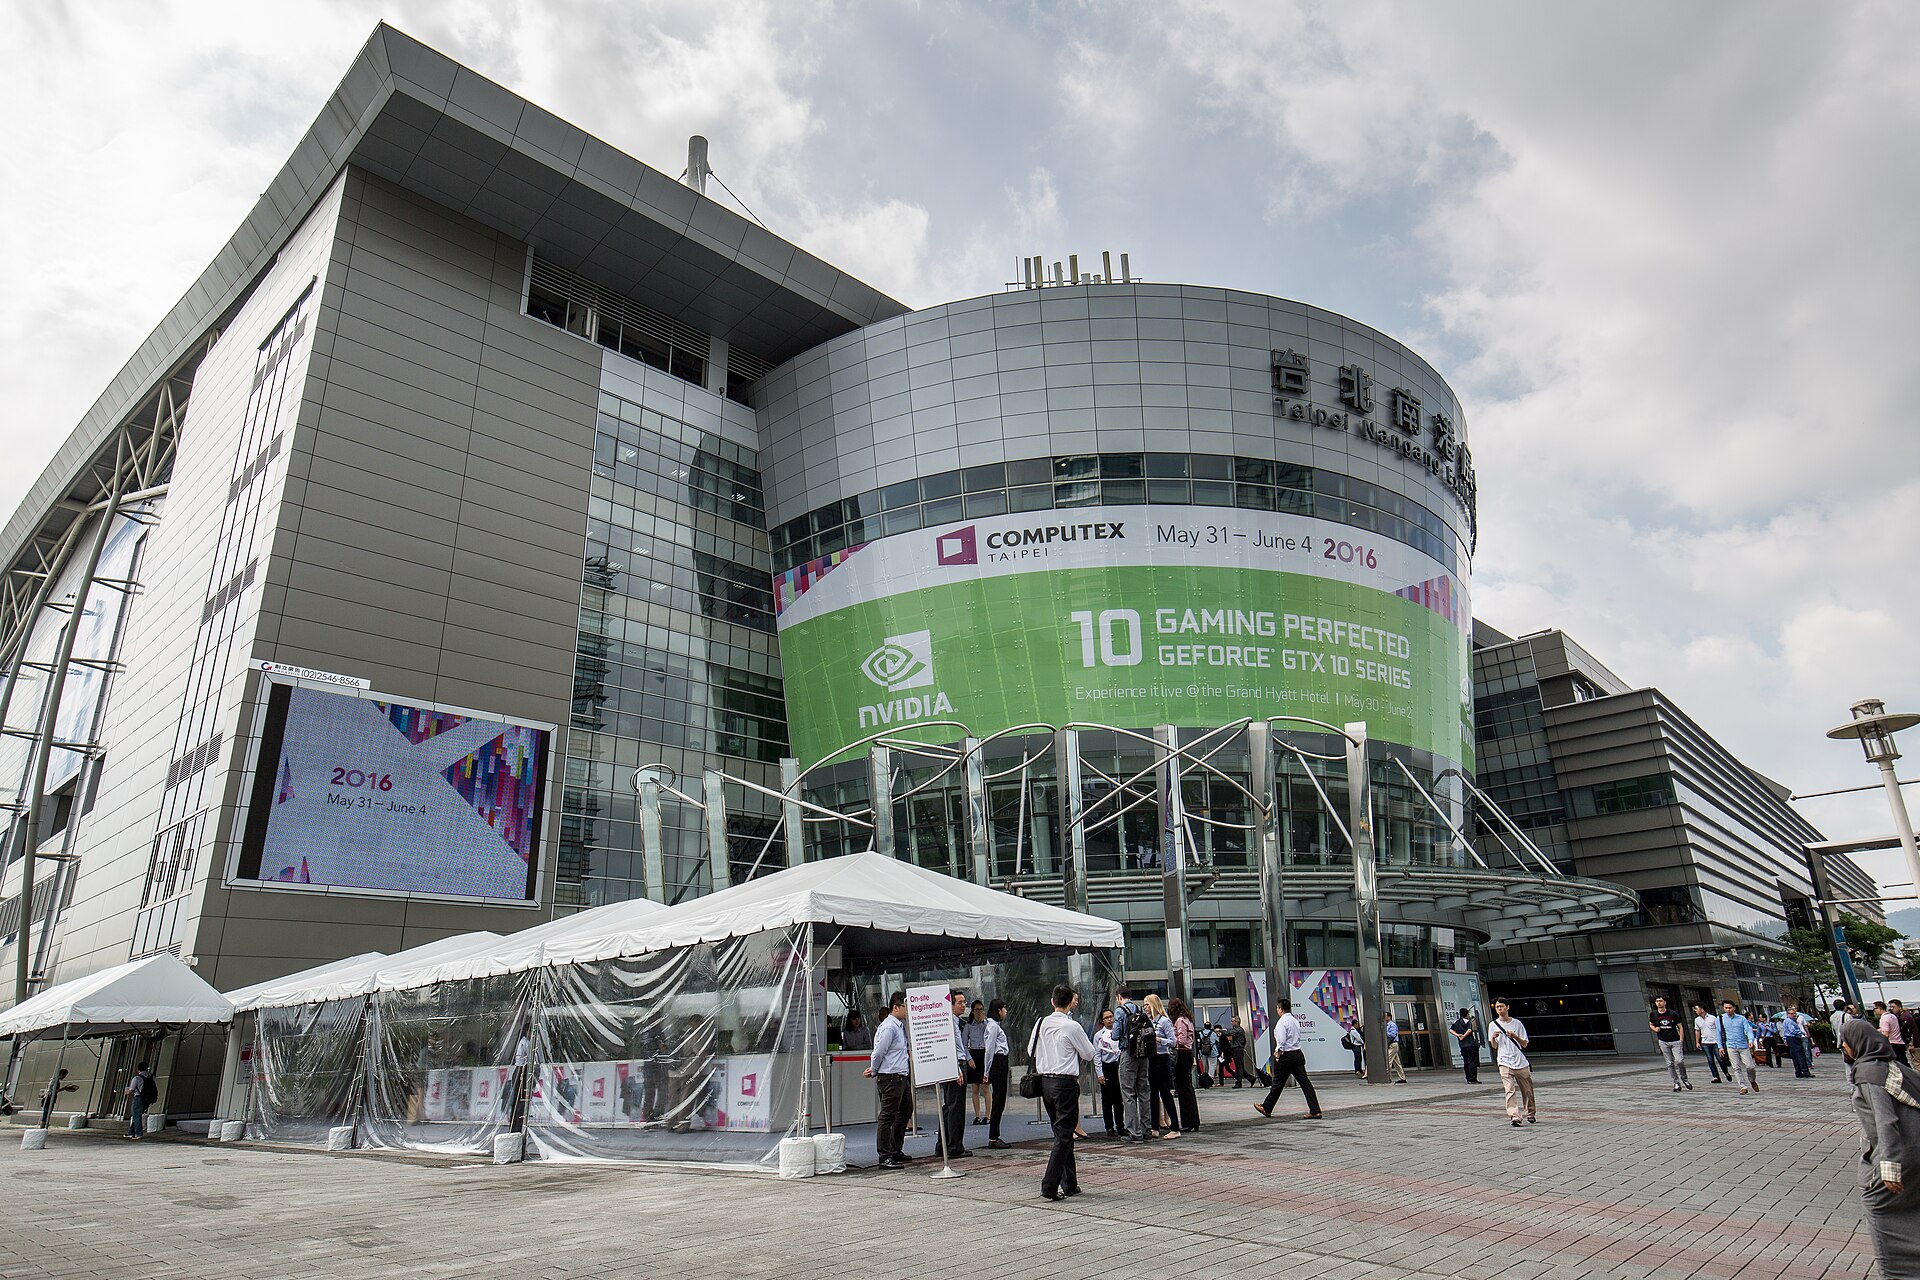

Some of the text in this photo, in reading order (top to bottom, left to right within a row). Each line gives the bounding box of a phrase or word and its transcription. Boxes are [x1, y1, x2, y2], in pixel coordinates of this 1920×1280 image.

[1274, 397, 1440, 476] Taipei Nangang
[986, 522, 1126, 549] COMPUTEX
[1157, 524, 1200, 548] May
[1206, 525, 1228, 544] 31
[1252, 529, 1296, 551] June
[1301, 535, 1312, 553] 4
[1323, 537, 1378, 570] 2016
[1071, 608, 1143, 668] 10
[1155, 608, 1410, 660] GAMING PERFECTED
[301, 669, 360, 687] (02)2546-8566
[1282, 649, 1326, 674] GTX
[1330, 654, 1350, 677] 10
[1355, 659, 1412, 690] SERIES
[1075, 686, 1147, 702] Experience
[1150, 685, 1159, 697] it
[1160, 684, 1183, 698] live
[1186, 684, 1200, 698] @
[1201, 684, 1222, 698] the
[1226, 685, 1262, 699] Grand
[1265, 687, 1298, 704] Hyatt
[1301, 689, 1330, 705] Hotel
[1344, 694, 1365, 712] May
[1365, 697, 1380, 712] 30
[1387, 702, 1406, 717] June
[1406, 706, 1413, 719] 2
[330, 766, 393, 792] 2016
[327, 792, 355, 810] May
[357, 796, 372, 809] 31
[386, 800, 416, 814] June
[419, 804, 427, 816] 4
[910, 994, 930, 1003] On-site
[910, 1002, 944, 1013] Registration
